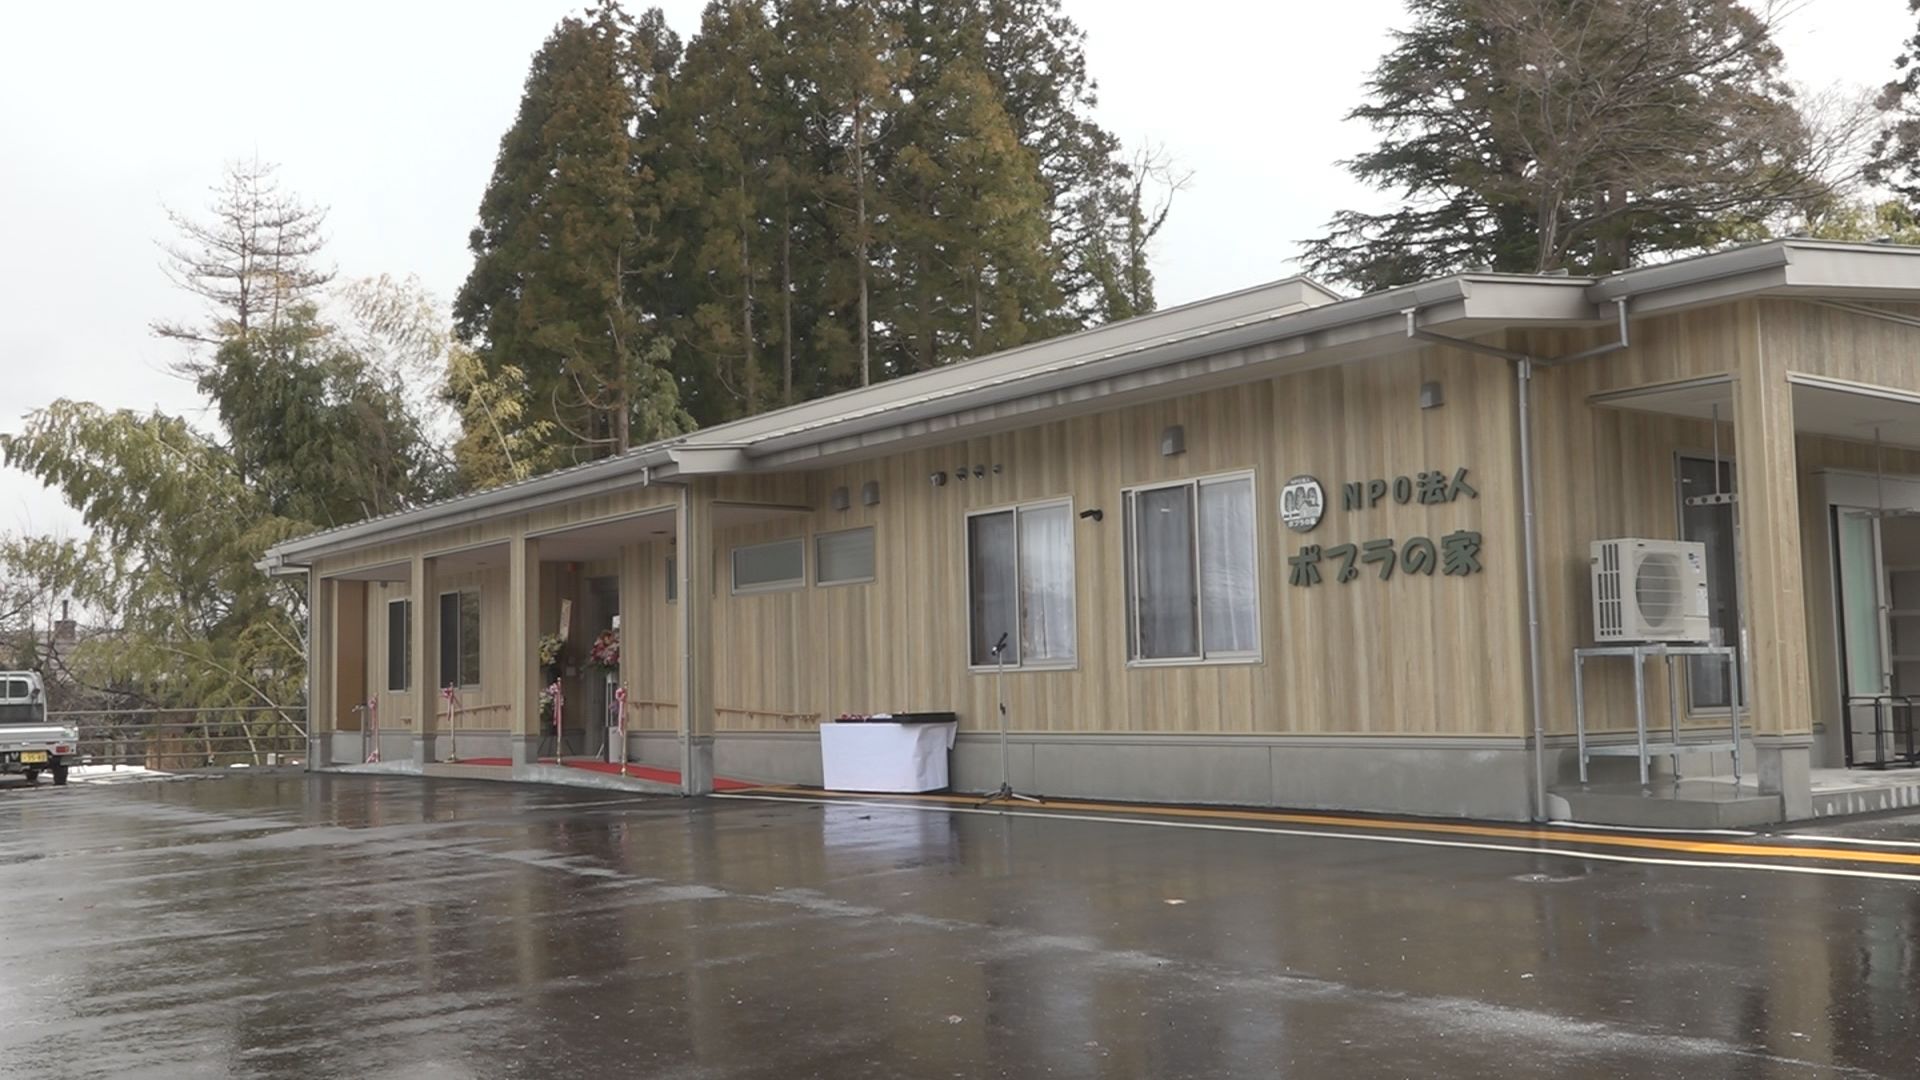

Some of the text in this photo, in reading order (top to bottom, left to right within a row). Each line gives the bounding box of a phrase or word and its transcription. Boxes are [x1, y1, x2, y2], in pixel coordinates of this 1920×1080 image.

[1342, 467, 1478, 512] NPO法人
[1288, 530, 1482, 587] ポプラの家
